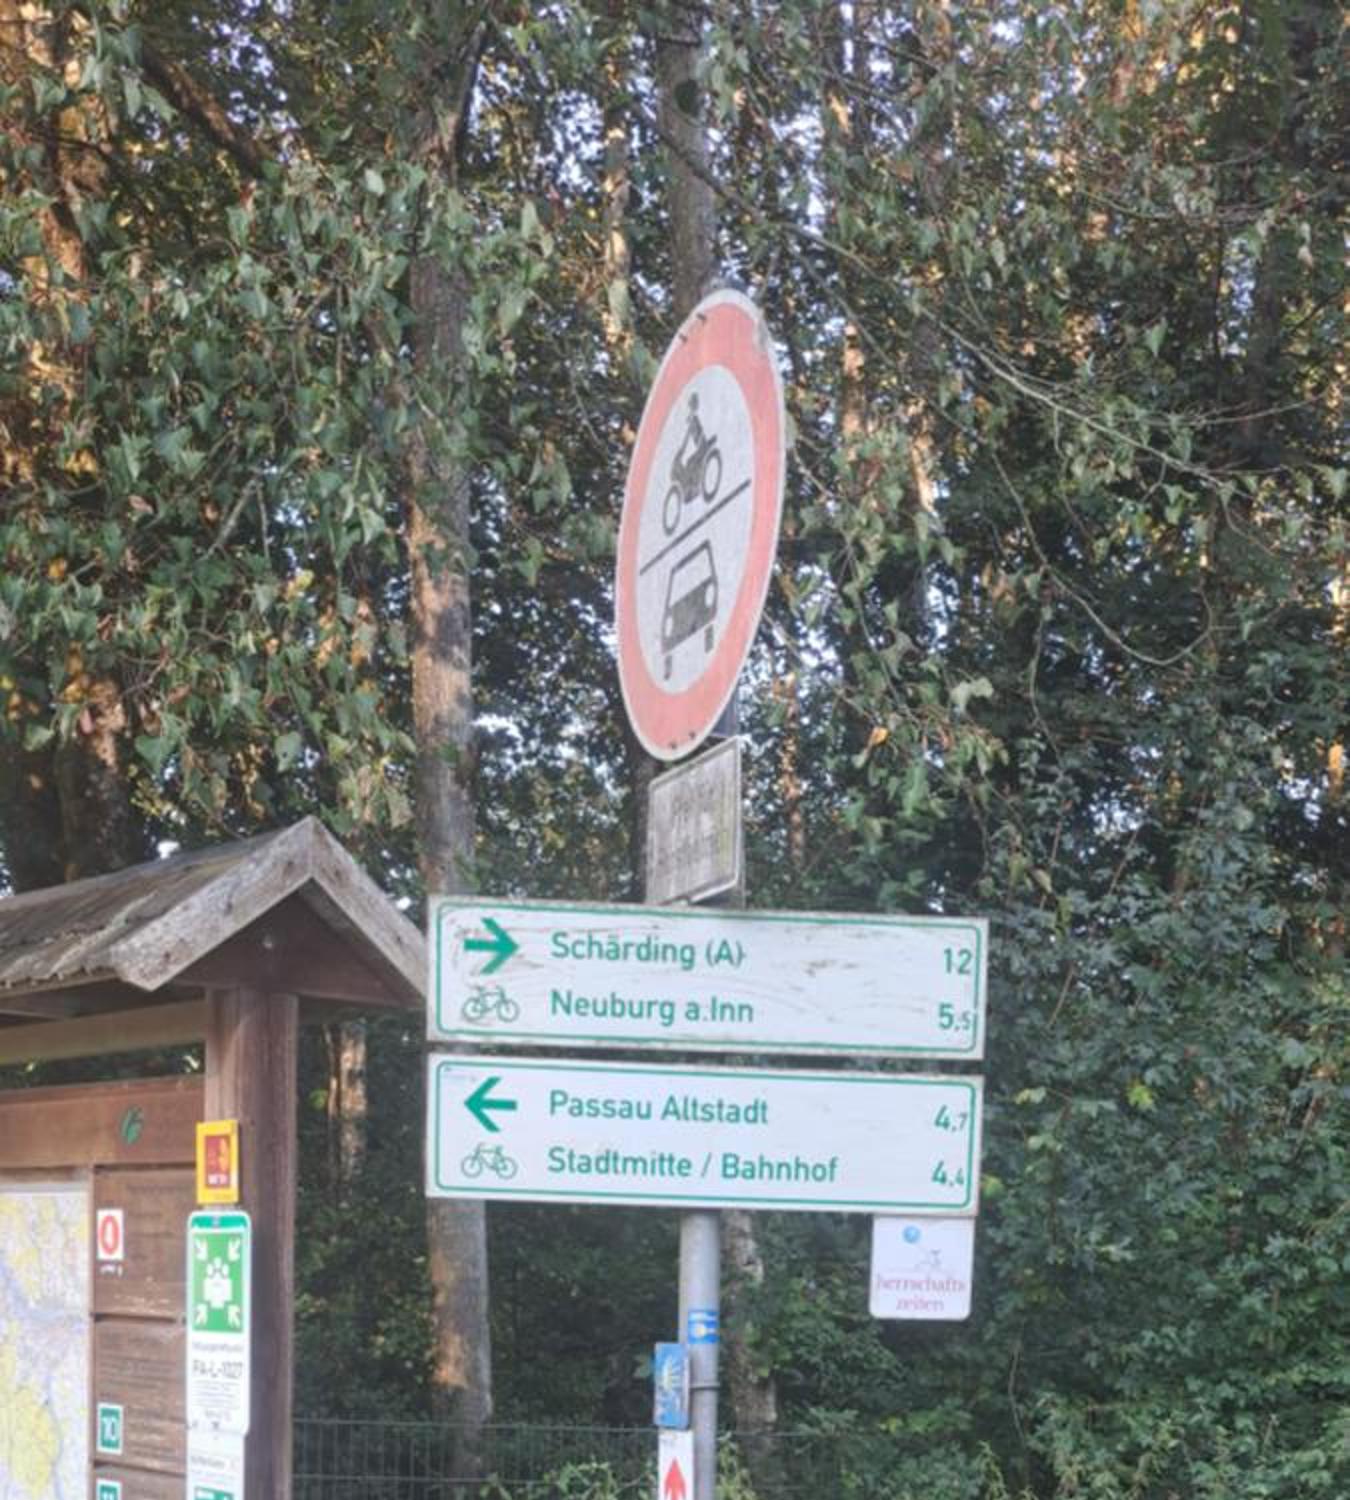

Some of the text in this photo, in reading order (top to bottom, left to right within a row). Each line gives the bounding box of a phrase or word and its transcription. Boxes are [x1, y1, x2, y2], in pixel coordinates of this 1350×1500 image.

[551, 930, 745, 972] Schärding (A)
[944, 947, 972, 974] 12
[550, 988, 676, 1027] Neuburg
[549, 1089, 769, 1124] Passau Altstadt
[547, 1145, 839, 1182] Stadtmitte / Bahnhof
